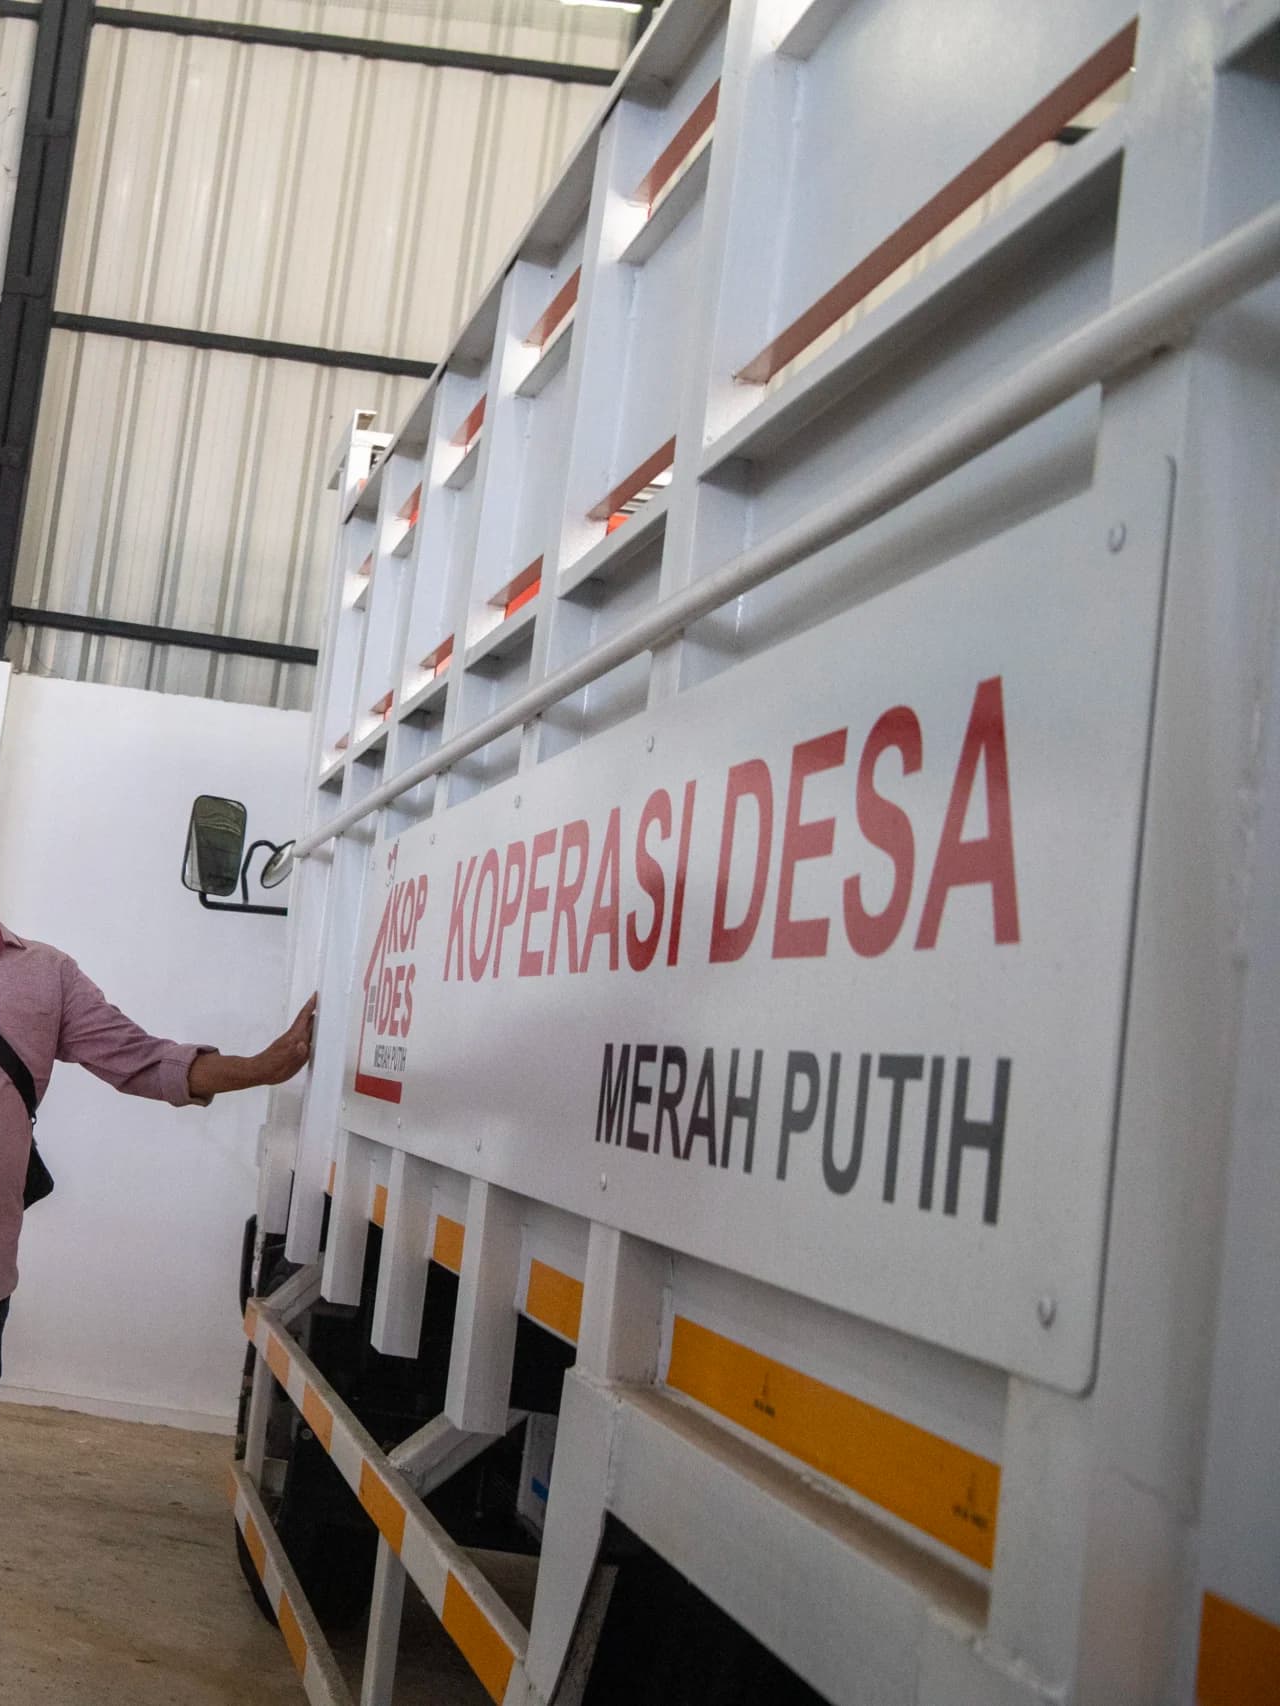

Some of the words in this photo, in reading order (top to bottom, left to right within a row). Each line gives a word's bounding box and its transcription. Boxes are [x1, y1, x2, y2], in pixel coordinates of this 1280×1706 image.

[443, 780, 697, 983] KOPERASI
[709, 676, 1021, 965] DESA
[386, 873, 428, 954] KOP
[377, 963, 417, 1039] DES
[595, 1043, 764, 1174] MERAH
[776, 1052, 1013, 1226] PUTIH
